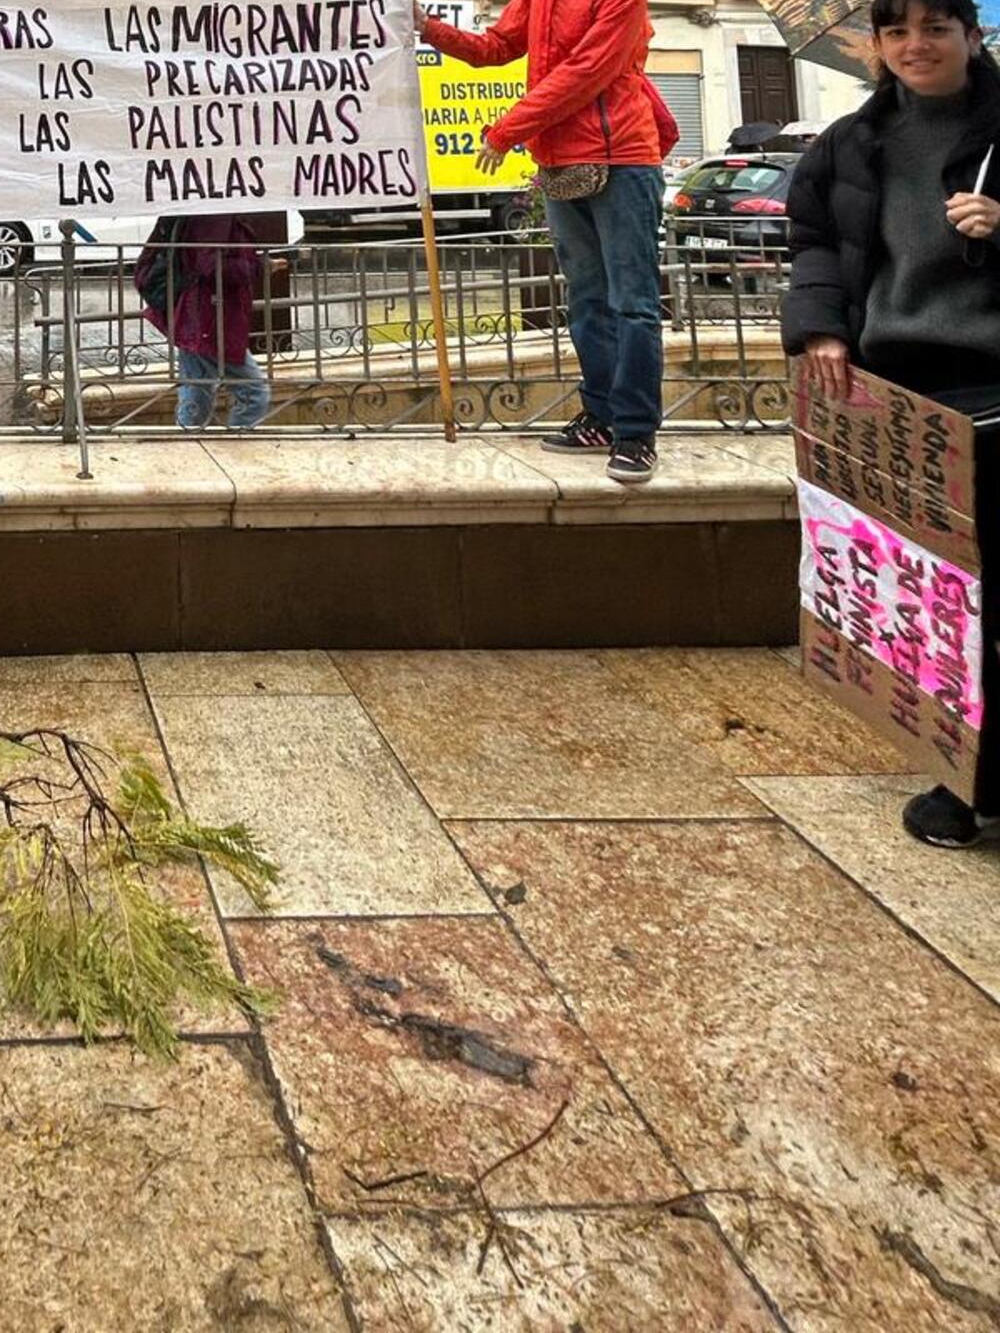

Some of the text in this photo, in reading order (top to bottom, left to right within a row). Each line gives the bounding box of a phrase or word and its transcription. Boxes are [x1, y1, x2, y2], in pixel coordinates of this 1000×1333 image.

[104, 4, 162, 53] LAS
[39, 53, 374, 100] LAS PRECARIZADAS
[19, 94, 362, 152] LAS PALESTINAS
[473, 107, 484, 124] A
[58, 148, 416, 206] LAS MALAS MADRES
[811, 545, 845, 682] HUELGA
[890, 545, 930, 737] HUELGA DE
